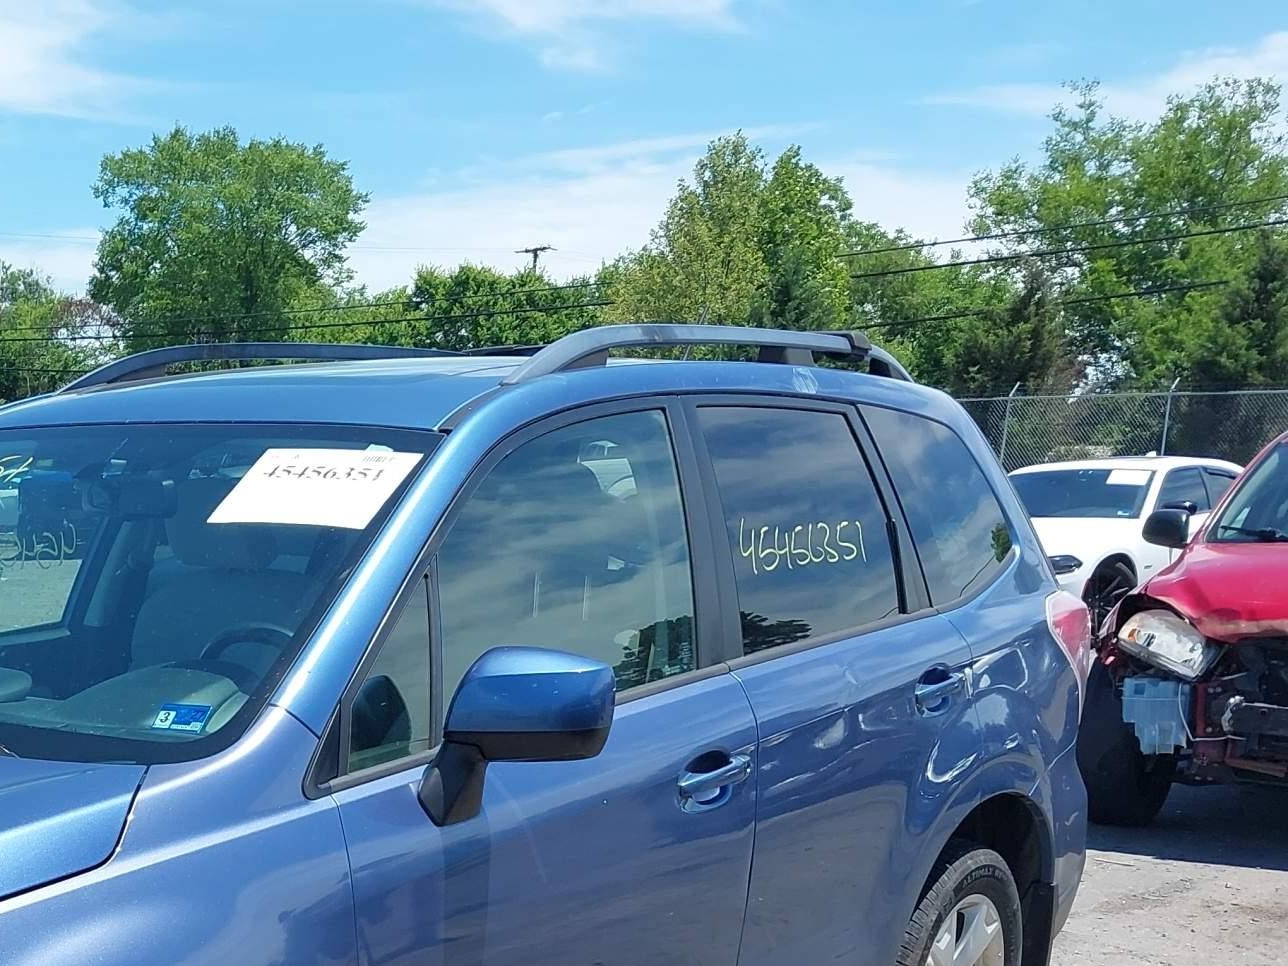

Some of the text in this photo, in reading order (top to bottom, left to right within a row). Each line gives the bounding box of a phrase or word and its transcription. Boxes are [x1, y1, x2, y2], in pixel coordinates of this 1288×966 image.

[263, 464, 385, 482] 45456351
[739, 517, 867, 576] 45456351
[159, 711, 171, 723] 3
